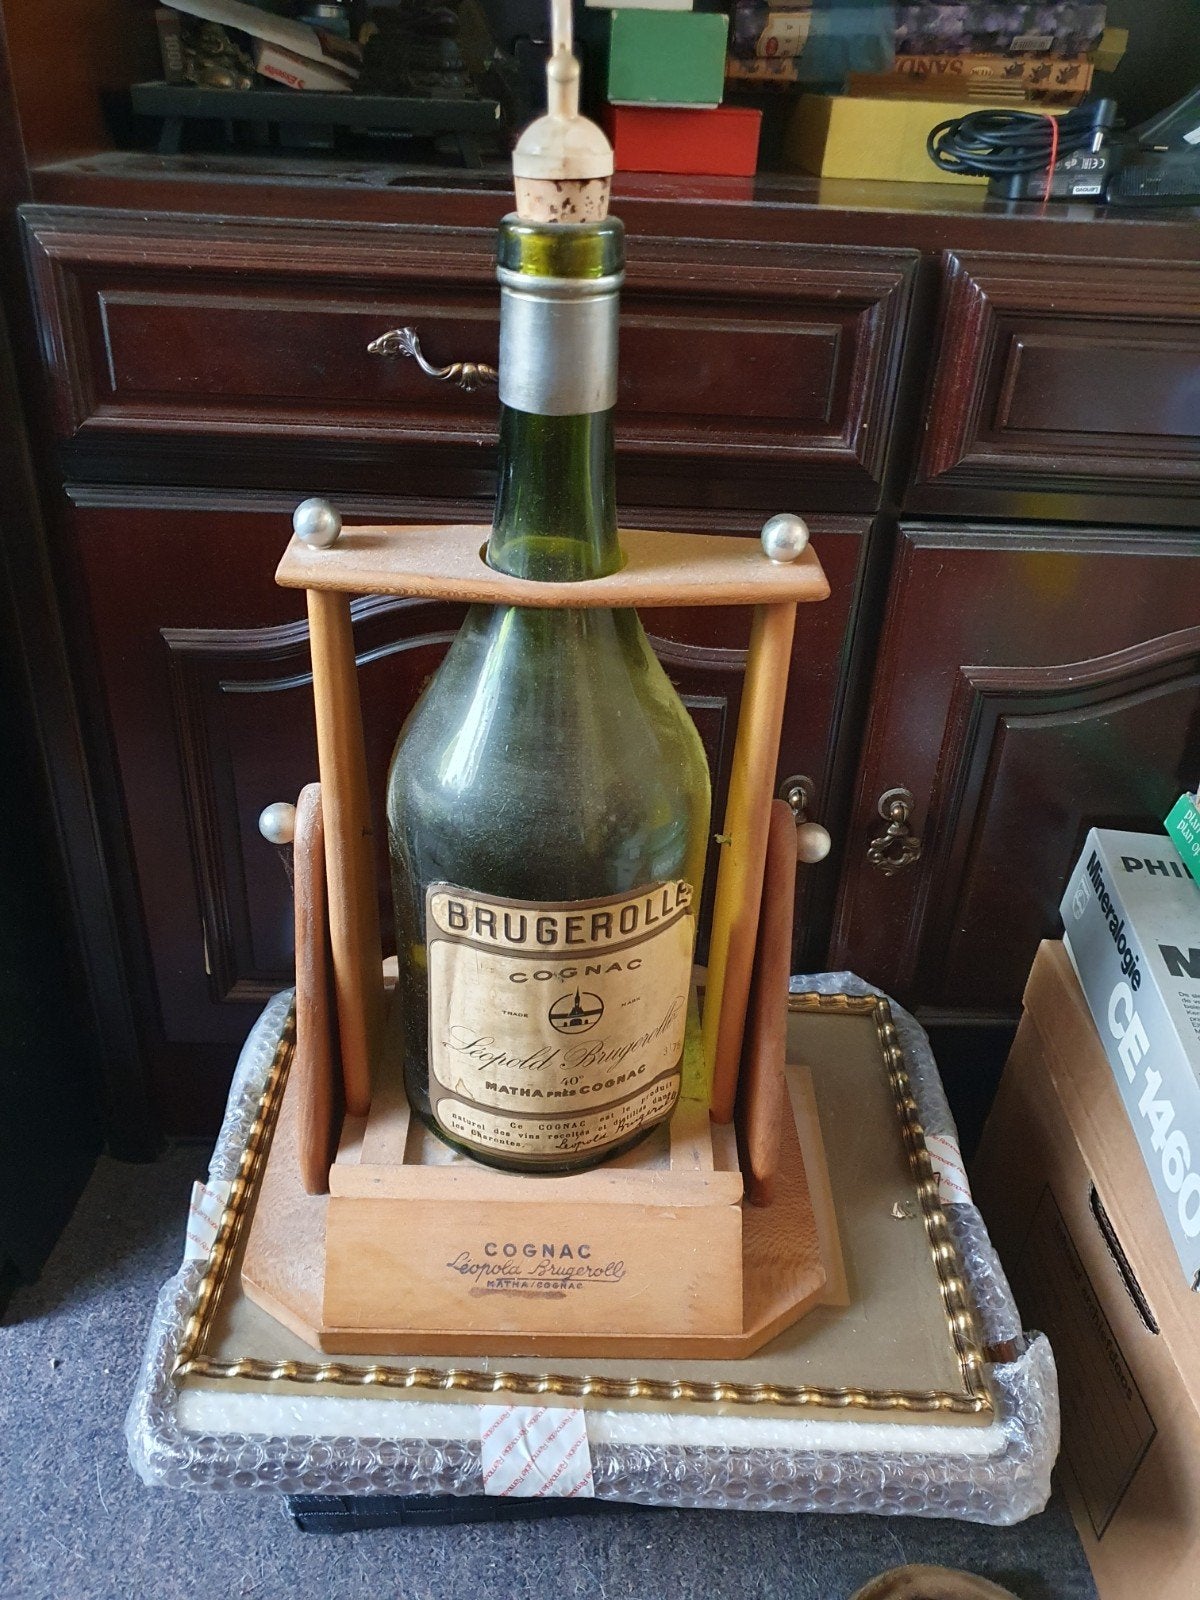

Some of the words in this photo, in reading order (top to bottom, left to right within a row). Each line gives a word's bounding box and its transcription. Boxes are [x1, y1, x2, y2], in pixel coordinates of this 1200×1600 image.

[447, 881, 691, 946] BRUGEROLLE
[1086, 849, 1142, 992] Mineralogie
[509, 958, 643, 984] COGNAC
[502, 1010, 529, 1018] TRADE
[620, 997, 641, 1008] MARK
[442, 1025, 561, 1071] Léopold
[559, 996, 686, 1074] Brugerolle
[1108, 981, 1151, 1085] CE
[485, 1081, 544, 1098] MATHA
[579, 1064, 647, 1095] COGNAC
[560, 1074, 585, 1086] 40°
[510, 1121, 523, 1130] Ce
[538, 1120, 586, 1131] COGNAC
[599, 1112, 614, 1122] est
[622, 1106, 631, 1114] le
[640, 1082, 672, 1104] produit
[451, 1121, 465, 1131] les
[470, 1129, 525, 1148] Charentes.
[452, 1113, 485, 1131] naturel
[493, 1128, 511, 1137] des
[518, 1131, 540, 1140] vins
[597, 1124, 607, 1132] et
[484, 1242, 592, 1260] COGNAC
